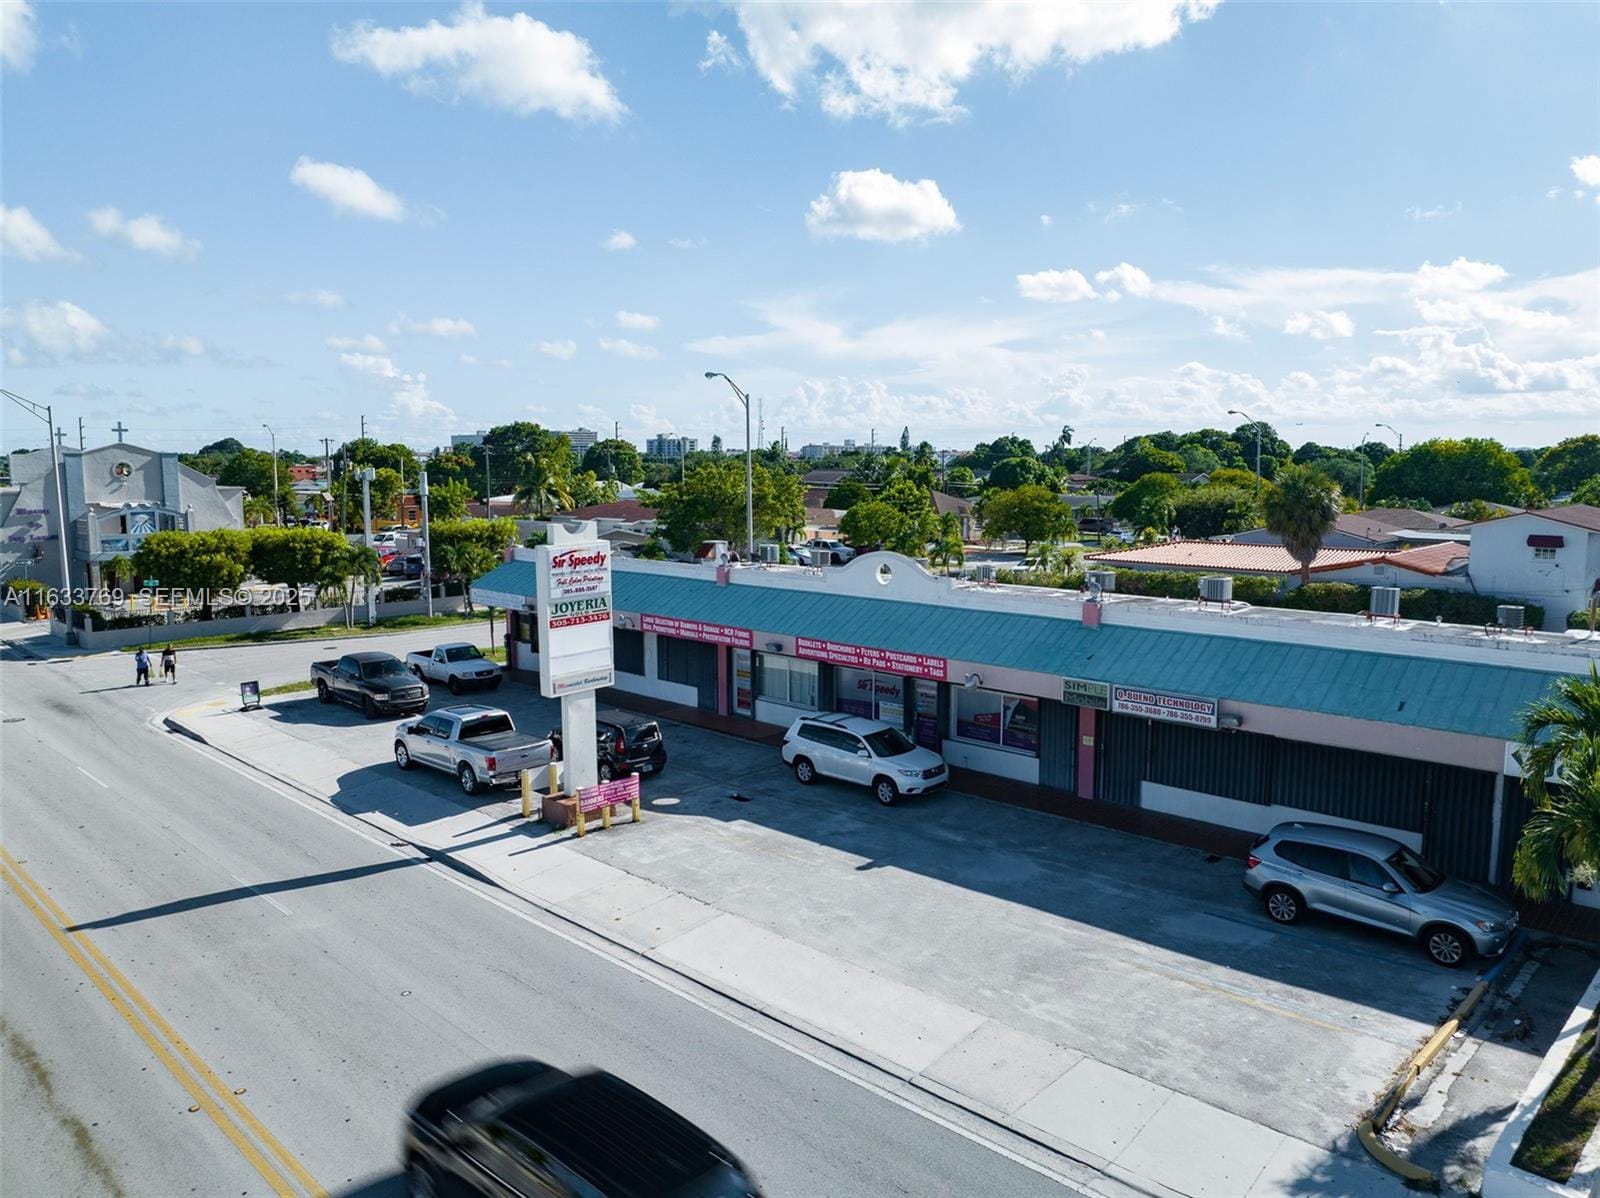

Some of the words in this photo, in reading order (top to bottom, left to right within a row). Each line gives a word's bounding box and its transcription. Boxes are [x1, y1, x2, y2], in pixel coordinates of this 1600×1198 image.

[552, 555, 565, 568] Sir
[568, 551, 607, 569] Speedy
[551, 597, 607, 615] JOYERIA
[798, 638, 821, 649] BOOKLETS
[827, 642, 856, 654] BROCHURES
[861, 647, 880, 658] FLYERS
[885, 651, 917, 664] POSTCARDS
[923, 657, 944, 668] LABELS
[798, 647, 828, 658] ADVERTISING
[829, 651, 858, 663] SPECIALTIES
[872, 658, 886, 668] PADS
[891, 661, 923, 673] STATIONERY
[929, 667, 944, 677] TAGS
[1064, 680, 1107, 697] SIMPLE
[1156, 695, 1213, 713] TECHNOLOGY
